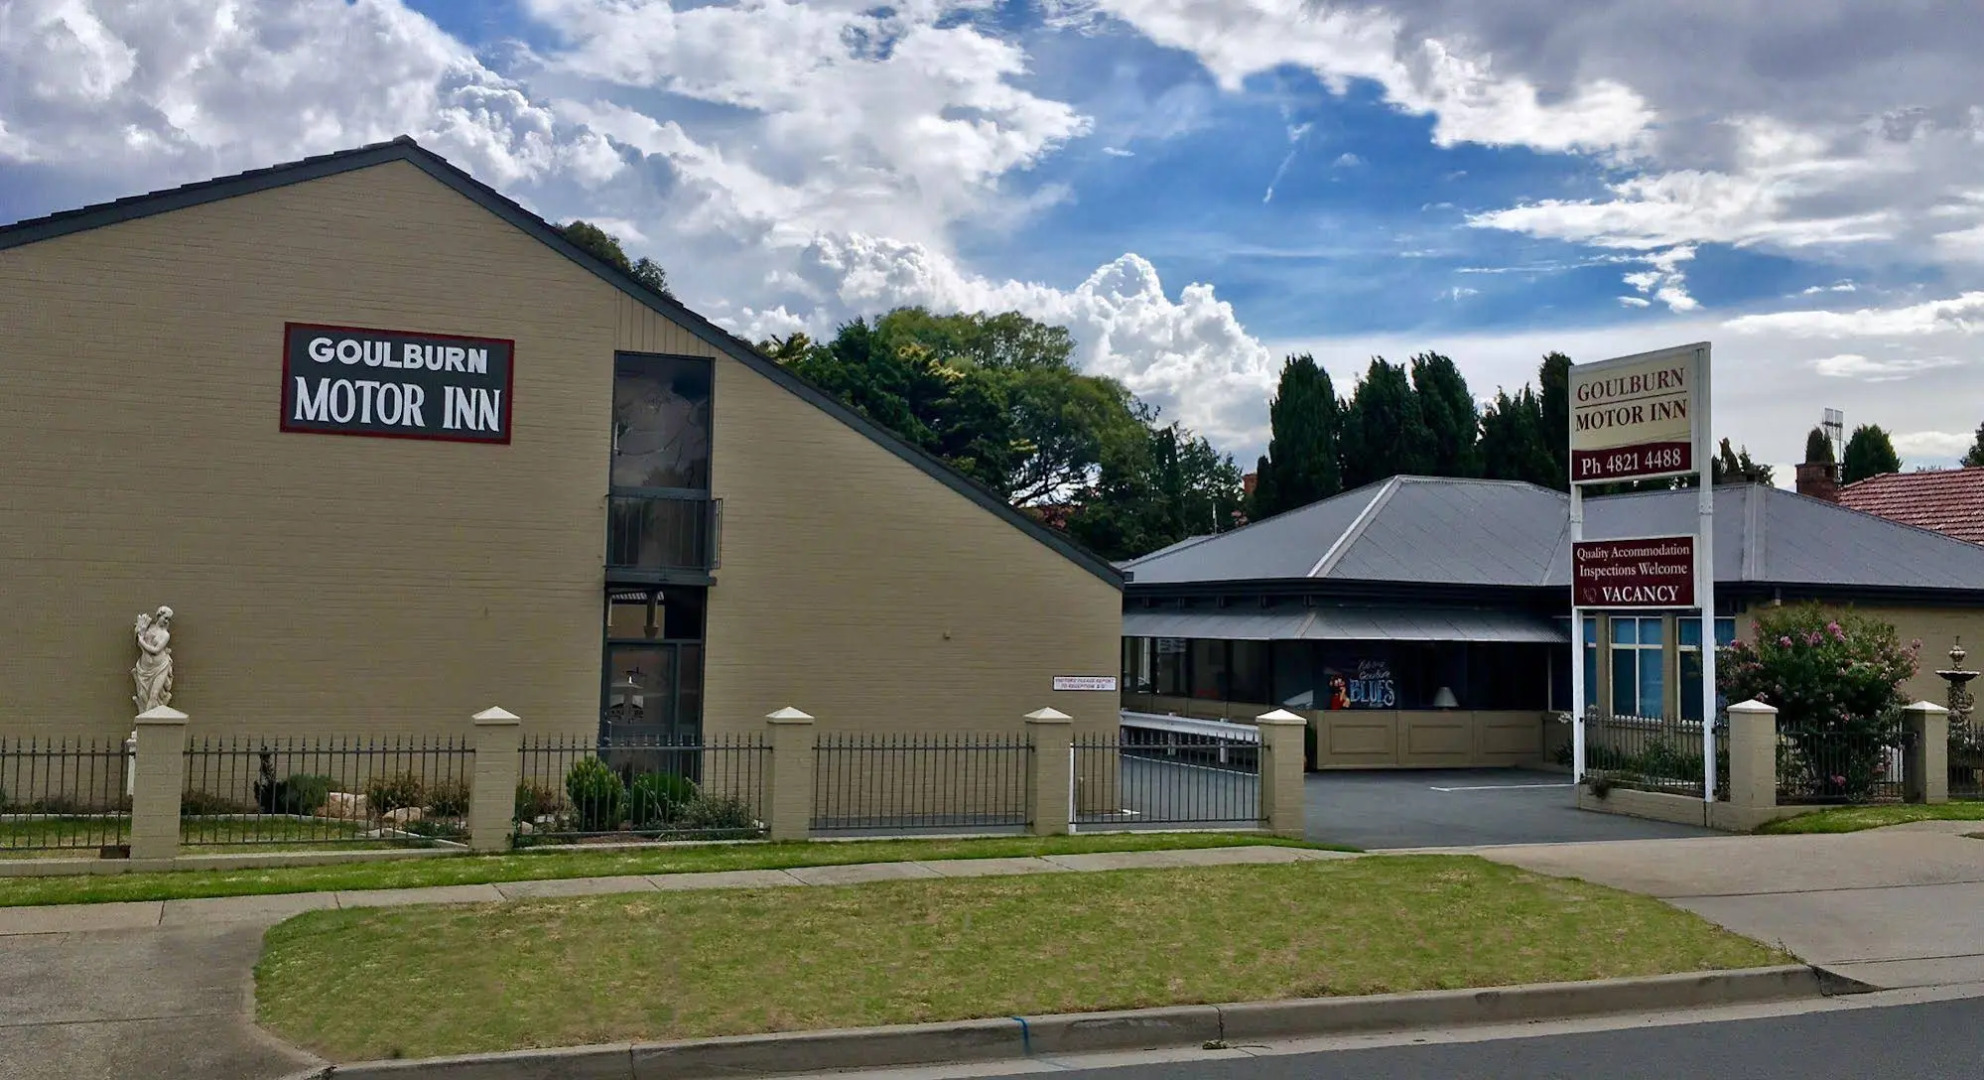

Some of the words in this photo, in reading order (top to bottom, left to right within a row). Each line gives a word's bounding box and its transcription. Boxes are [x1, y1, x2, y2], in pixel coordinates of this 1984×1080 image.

[308, 337, 488, 374] GOULBURN
[1577, 368, 1684, 401] GOULBURN
[294, 376, 426, 427] MOTOR
[442, 385, 502, 432] INN
[1575, 405, 1645, 432] MOTOR
[1650, 399, 1688, 421] INN
[1581, 457, 1601, 476] Ph
[1606, 452, 1639, 473] 4821
[1644, 448, 1681, 469] 4488
[1577, 547, 1609, 562] Quality
[1611, 544, 1690, 558] Accommodation
[1580, 563, 1636, 580] Inspections
[1639, 562, 1687, 575] Welcome
[1602, 585, 1679, 603] VACANCY
[1349, 679, 1395, 706] BLUES
